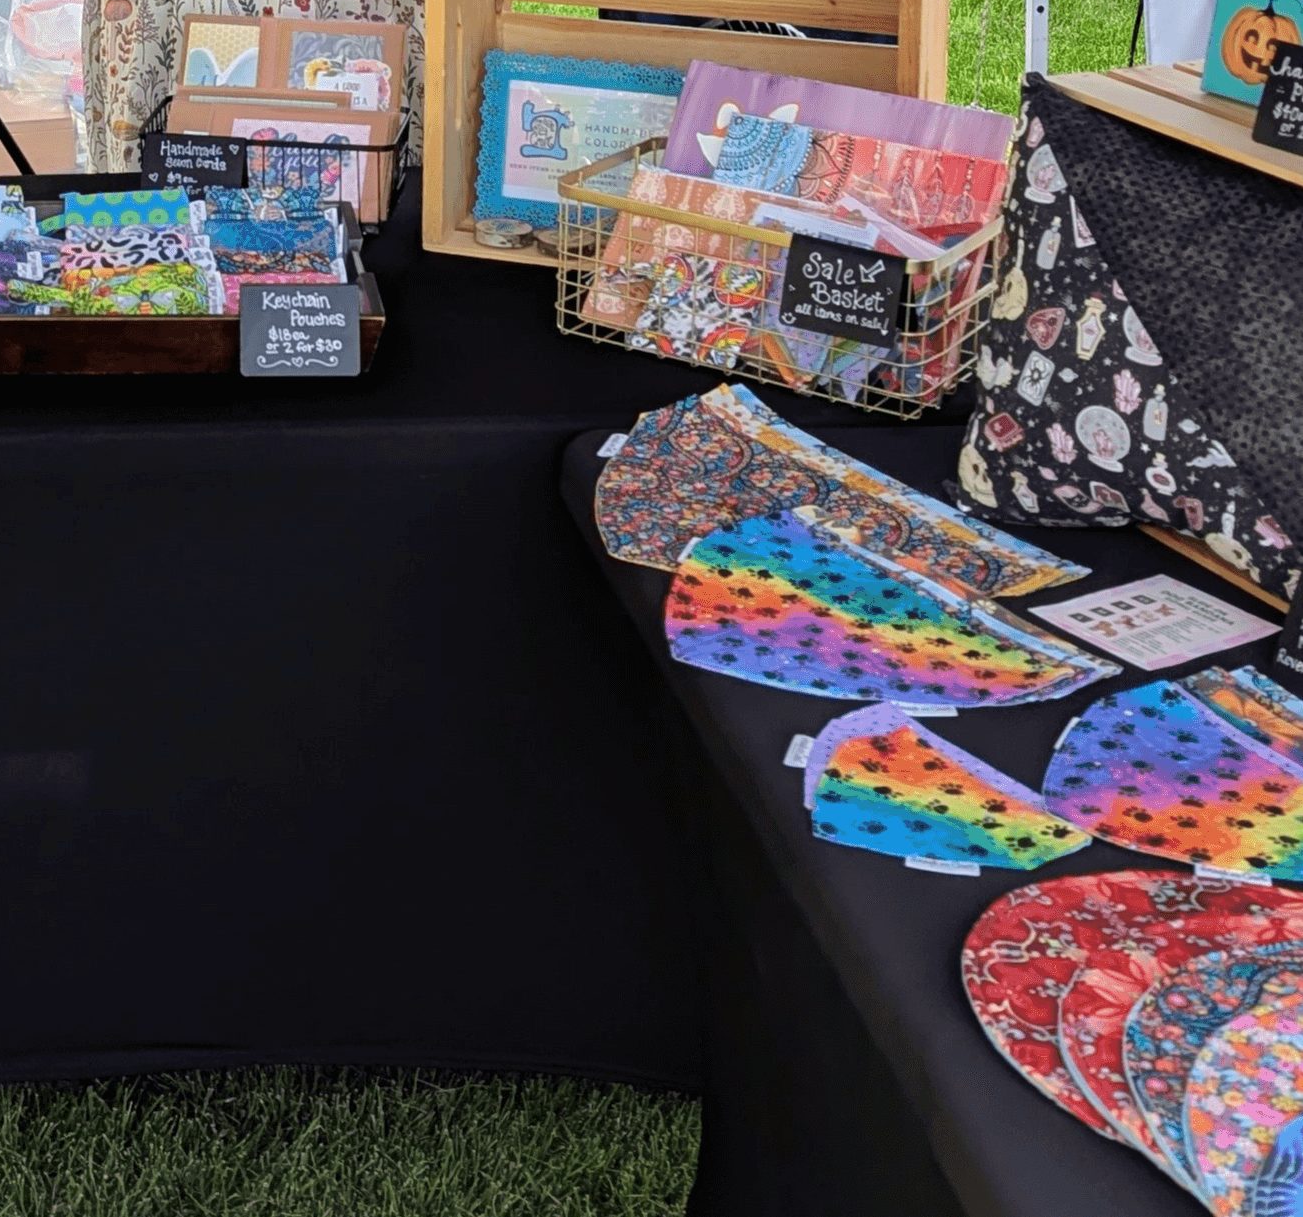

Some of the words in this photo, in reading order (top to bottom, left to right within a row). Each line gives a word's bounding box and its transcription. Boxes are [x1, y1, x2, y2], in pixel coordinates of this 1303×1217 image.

[160, 139, 224, 158] Handmade
[584, 136, 634, 149] COLOR
[802, 251, 857, 285] Sale
[261, 290, 332, 310] Keychain
[808, 280, 885, 314] Basket
[290, 308, 346, 327] Pouches
[794, 303, 813, 316] all
[844, 313, 859, 325] on
[265, 342, 279, 354] or
[282, 342, 295, 354] 2
[295, 341, 313, 353] for
[314, 337, 343, 353] $30
